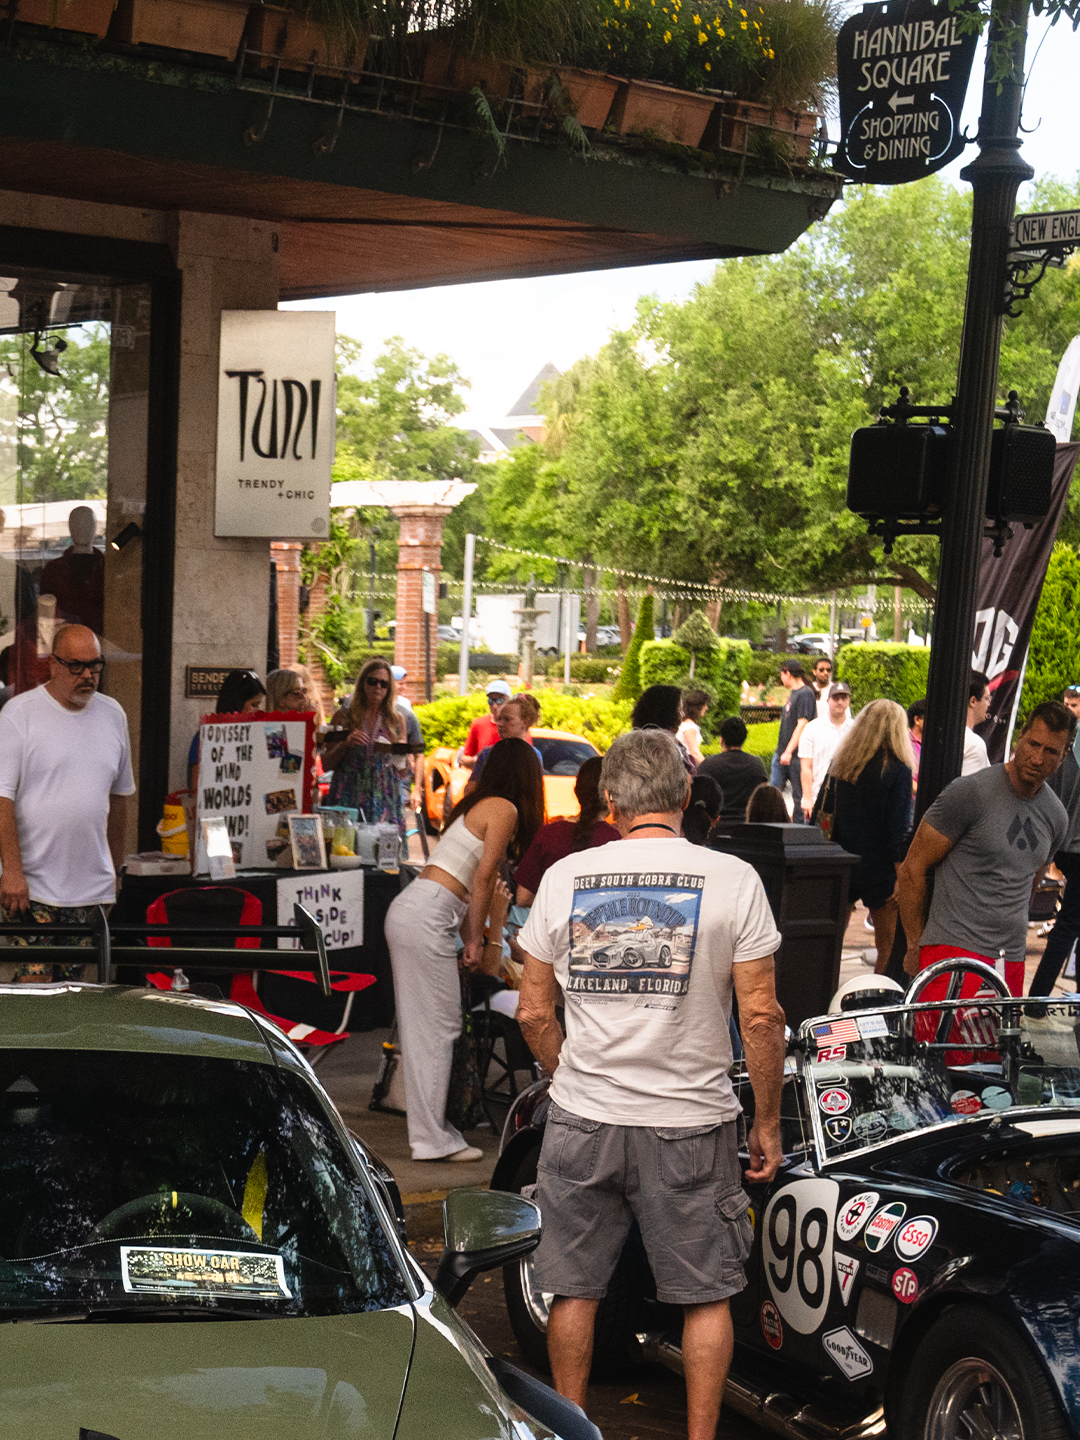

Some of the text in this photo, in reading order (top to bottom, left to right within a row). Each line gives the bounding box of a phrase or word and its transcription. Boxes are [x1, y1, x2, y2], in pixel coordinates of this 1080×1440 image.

[853, 17, 963, 59] HANNIBAL
[857, 51, 951, 92] SQUARE
[860, 111, 939, 140] SHOPPING
[864, 136, 931, 161] & DINING
[1022, 218, 1047, 242] NEW
[238, 479, 285, 489] TRENDY
[191, 672, 230, 684] BENDE
[208, 725, 251, 744] ODYSSEY
[211, 745, 252, 763] OF THE
[215, 762, 241, 783] MIND
[203, 784, 252, 810] WORLDS
[574, 874, 704, 890] DEEP SOUTH COBRA CLUB
[296, 884, 342, 904] THINK
[639, 978, 689, 993] FLORIDA
[817, 1045, 845, 1063] RS
[871, 1215, 898, 1231] Castrol
[164, 1252, 240, 1270] SHOW CAR
[769, 1194, 828, 1309] 98
[894, 1270, 916, 1299] STP
[826, 1339, 868, 1367] GOODYEAR
